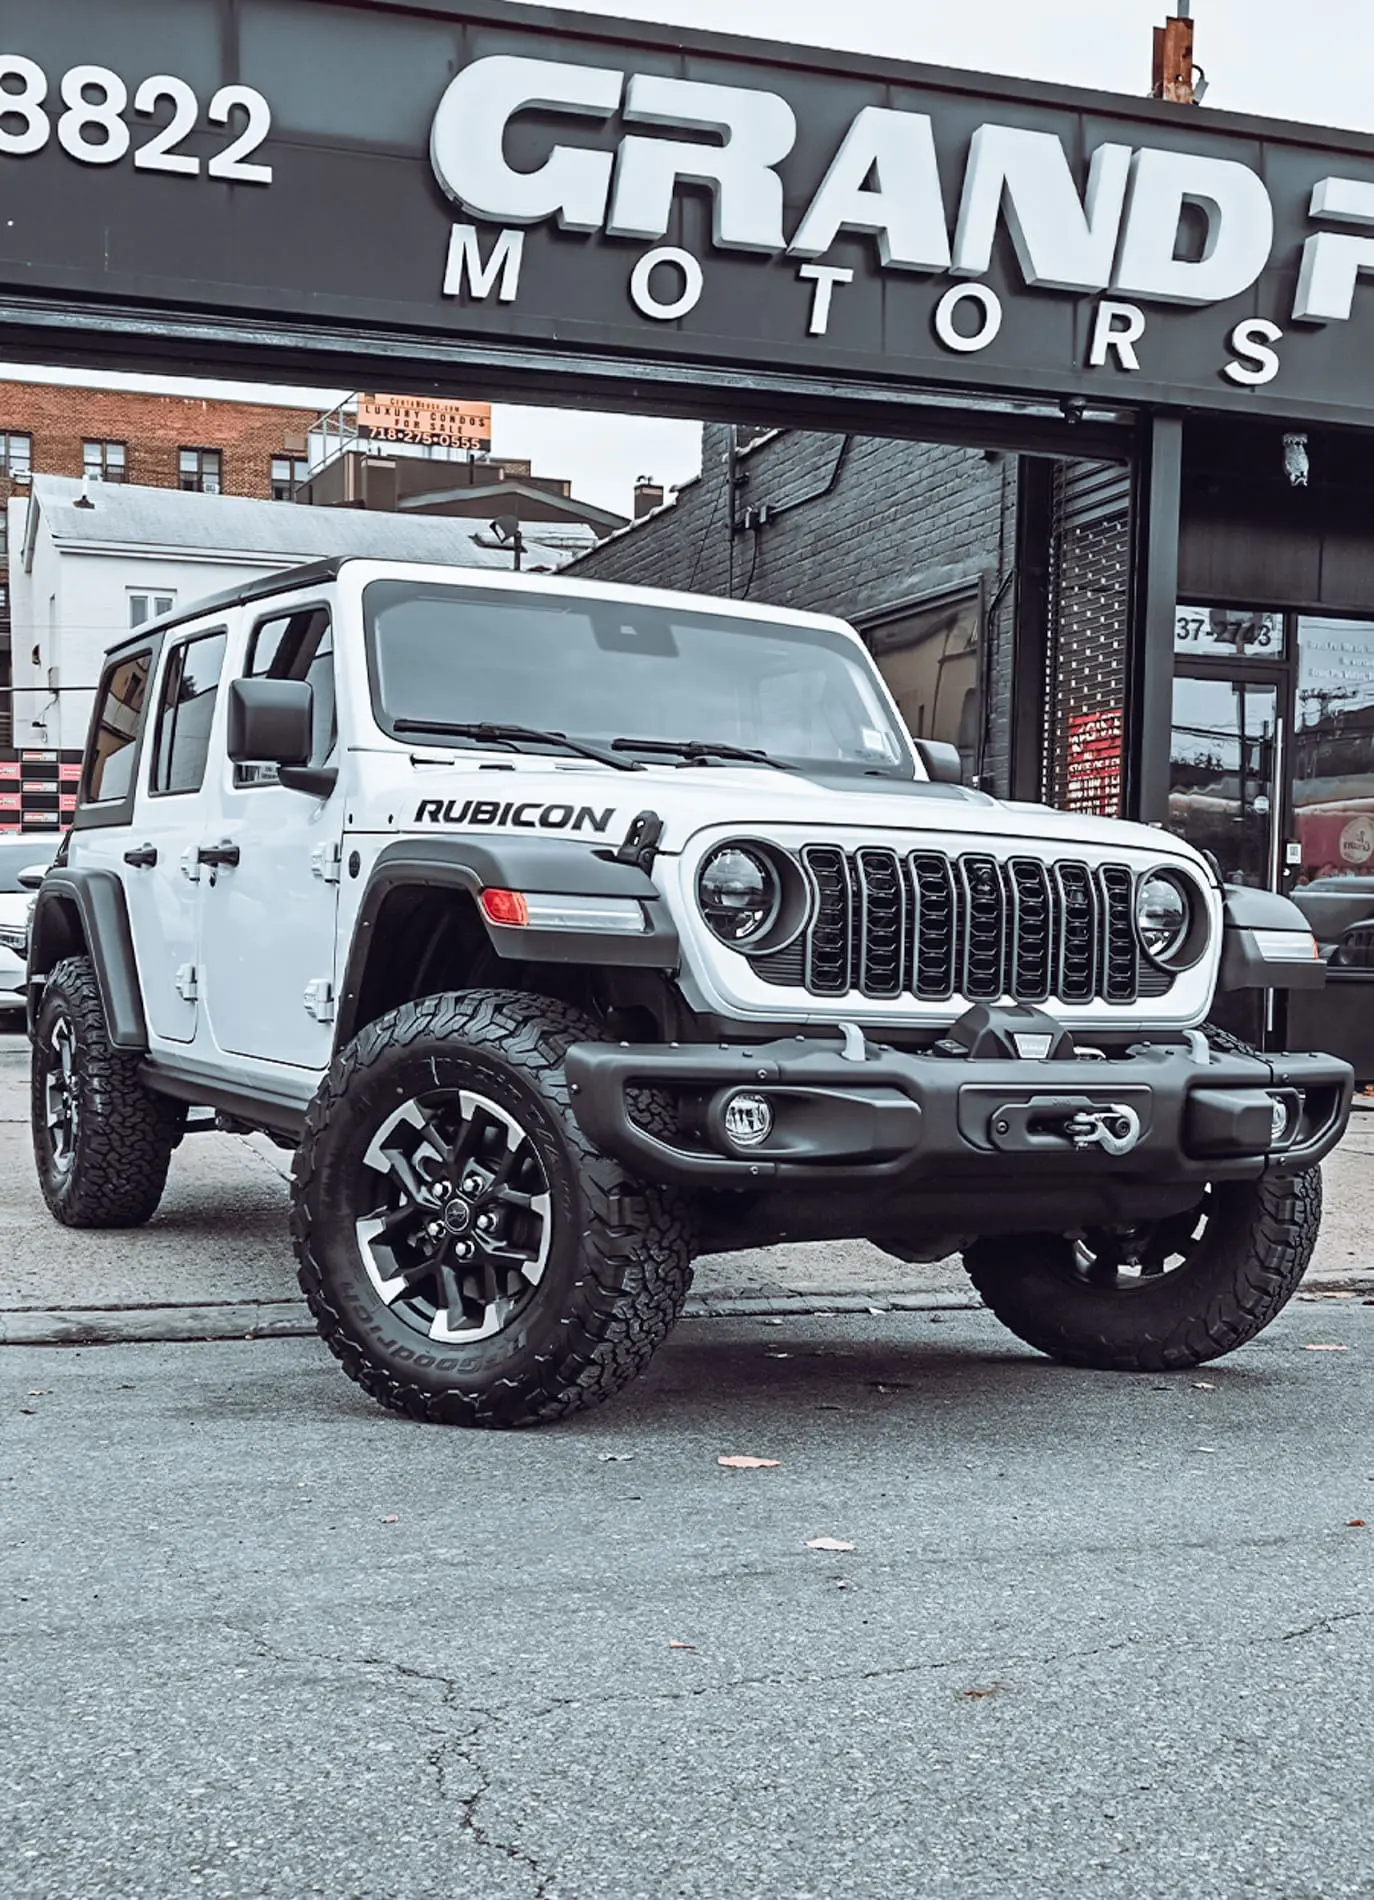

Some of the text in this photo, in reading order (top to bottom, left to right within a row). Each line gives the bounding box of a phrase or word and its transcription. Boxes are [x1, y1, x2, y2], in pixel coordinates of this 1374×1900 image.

[430, 55, 1273, 307] GRAND
[443, 223, 1284, 386] MOTORS
[365, 405, 486, 428] LUXURY CONDOS
[394, 418, 463, 435] FOR SALE
[413, 799, 616, 833] RUBICON
